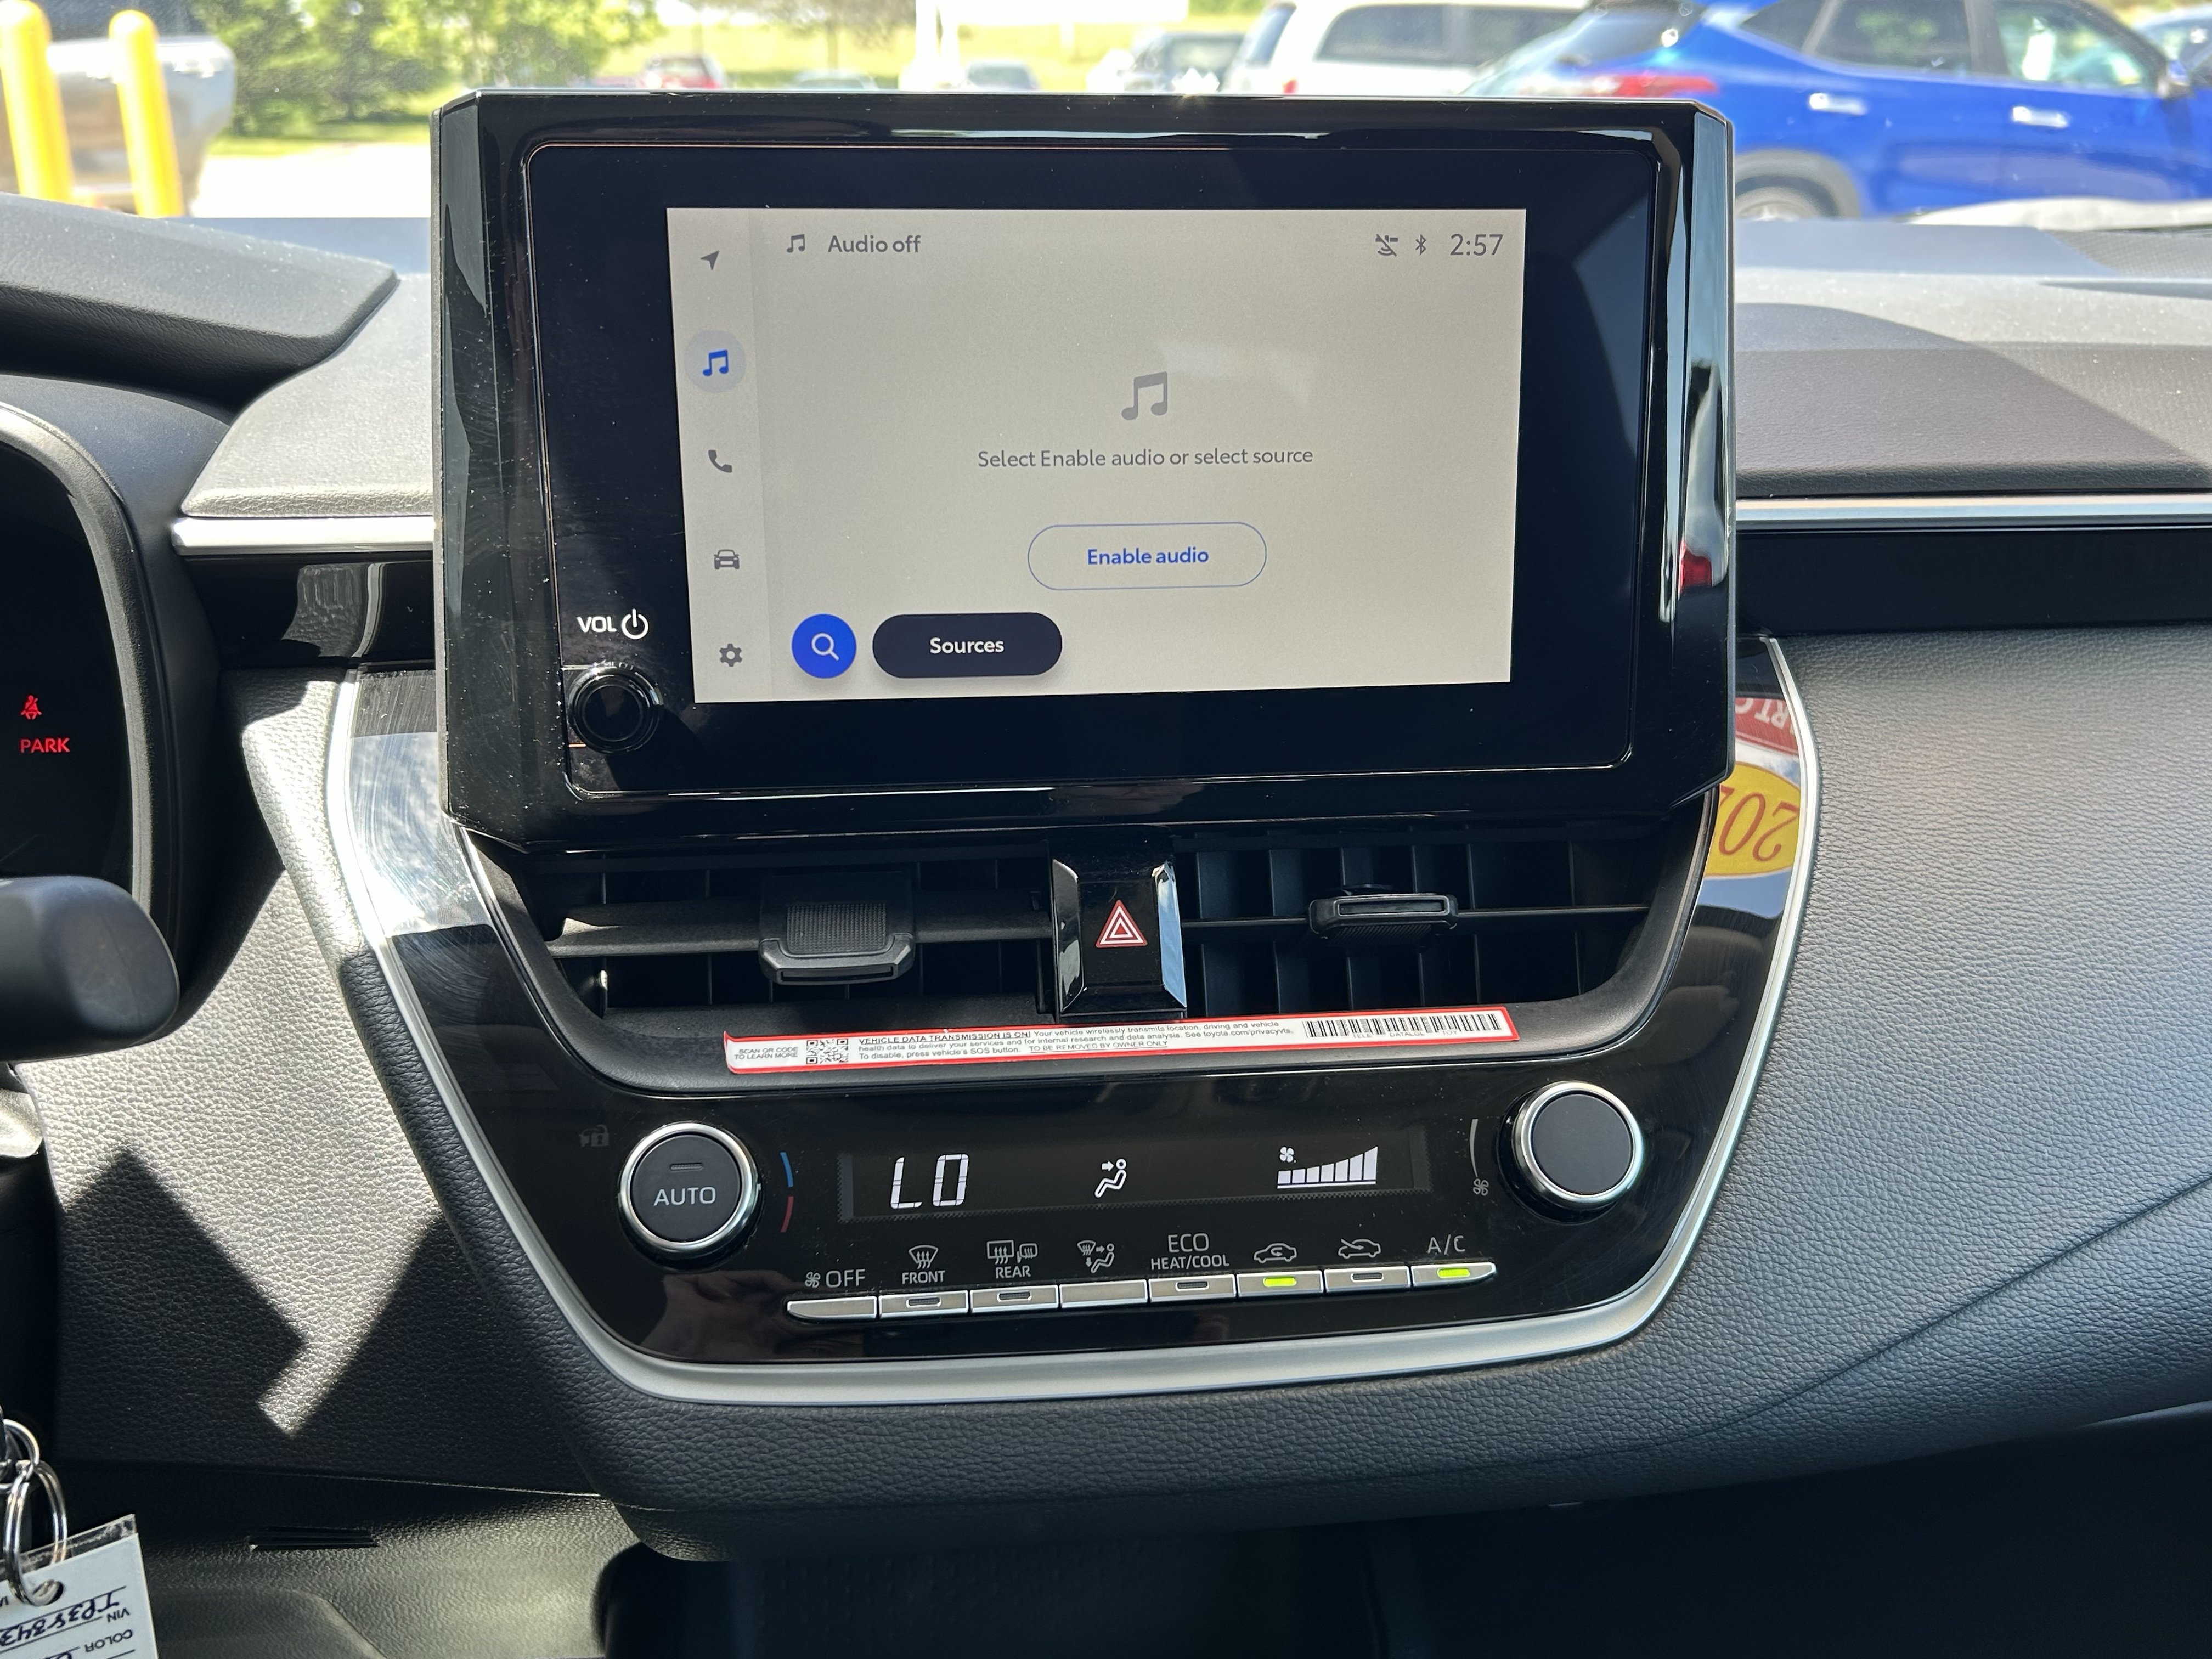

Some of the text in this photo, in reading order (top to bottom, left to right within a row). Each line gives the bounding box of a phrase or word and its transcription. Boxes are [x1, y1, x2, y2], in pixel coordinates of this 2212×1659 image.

[828, 235, 922, 253] Audio off
[1450, 234, 1503, 256] 2:57
[978, 448, 1313, 467] Select Enable audio or select source
[1088, 546, 1209, 565] Enable audio
[577, 616, 617, 633] VOL
[929, 637, 1005, 654] Sources
[20, 737, 70, 753] PARK
[859, 1036, 900, 1045] VEHICLE
[929, 1031, 1000, 1042] TRANSMISSION
[1085, 1026, 1125, 1035] wirelessly
[890, 1154, 969, 1209] LO
[654, 1186, 716, 1206] AUTO
[1168, 1233, 1209, 1253] ECO
[1427, 1234, 1466, 1254] A/C
[1152, 1255, 1229, 1270] HEAT/COOL
[826, 1269, 866, 1288] OFF
[902, 1270, 945, 1284] FRONT
[996, 1266, 1031, 1279] REAR
[106, 1607, 131, 1623] VIN
[84, 1629, 133, 1652] COLOR
